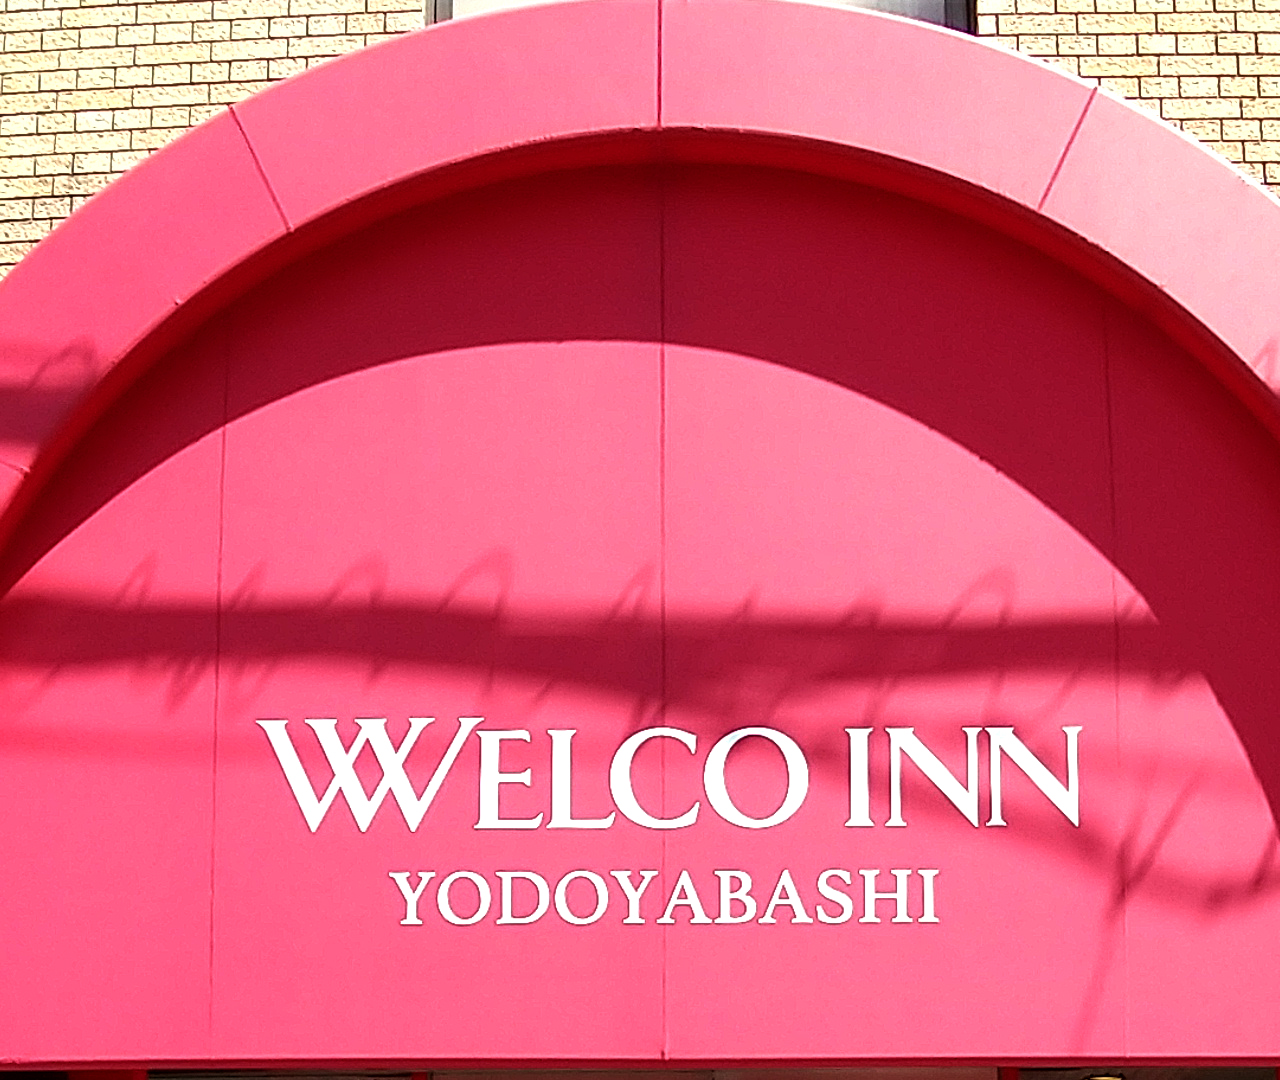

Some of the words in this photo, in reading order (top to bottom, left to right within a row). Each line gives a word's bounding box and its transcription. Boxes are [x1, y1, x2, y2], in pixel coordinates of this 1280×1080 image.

[255, 717, 809, 833] WELCO
[845, 725, 1083, 829] INN
[389, 869, 940, 926] YODOYABASHI
